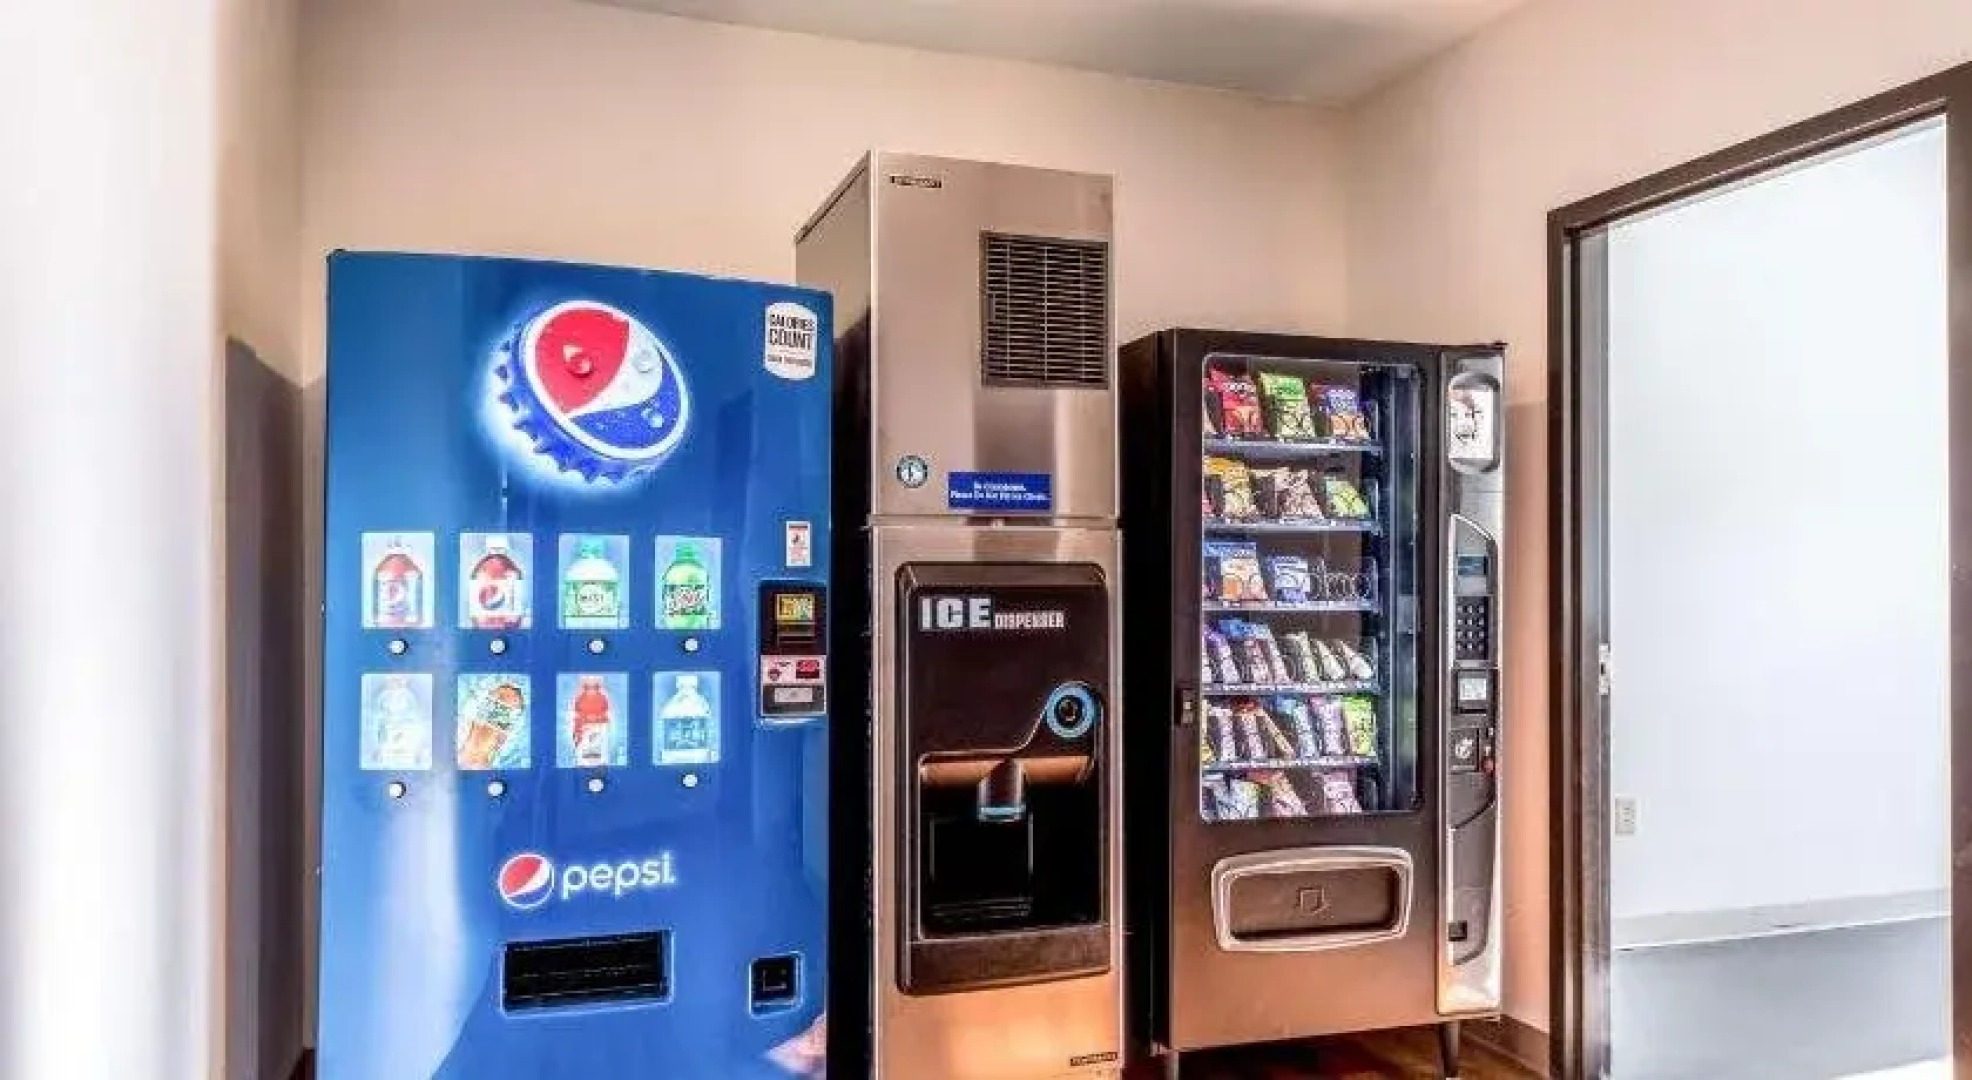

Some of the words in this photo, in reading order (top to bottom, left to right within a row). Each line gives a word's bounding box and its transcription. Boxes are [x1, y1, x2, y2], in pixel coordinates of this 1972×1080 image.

[769, 328, 812, 350] COUNT
[921, 598, 992, 629] ICE
[994, 610, 1065, 630] DISPENSER
[562, 852, 676, 900] pepsi
